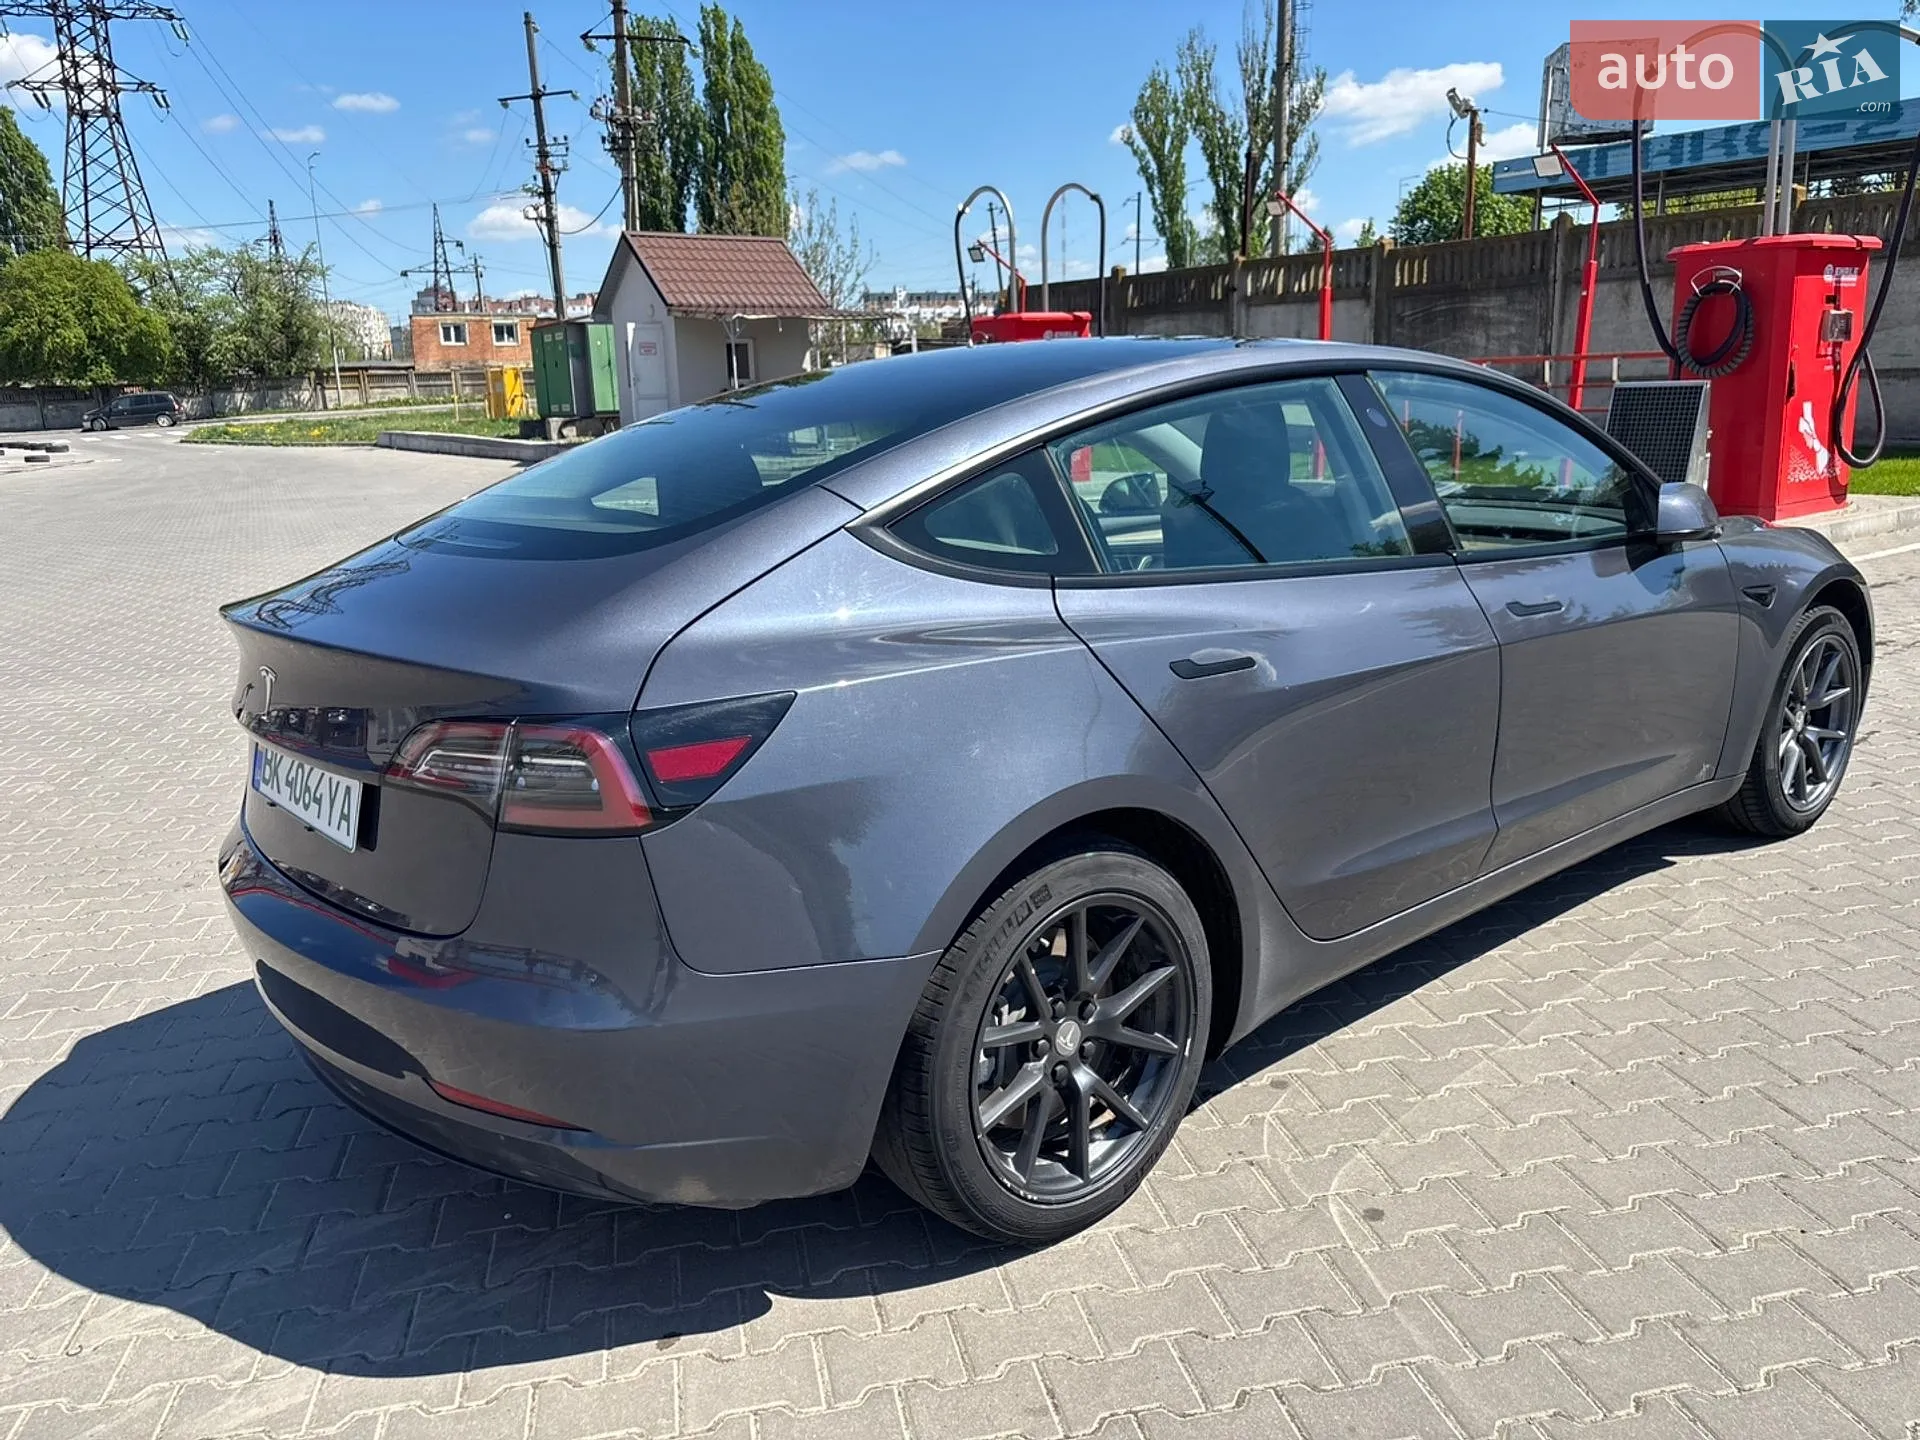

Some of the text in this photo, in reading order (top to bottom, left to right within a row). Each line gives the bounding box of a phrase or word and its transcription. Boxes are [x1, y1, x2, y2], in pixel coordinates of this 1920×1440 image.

[262, 748, 351, 837] BK 4064 YA
